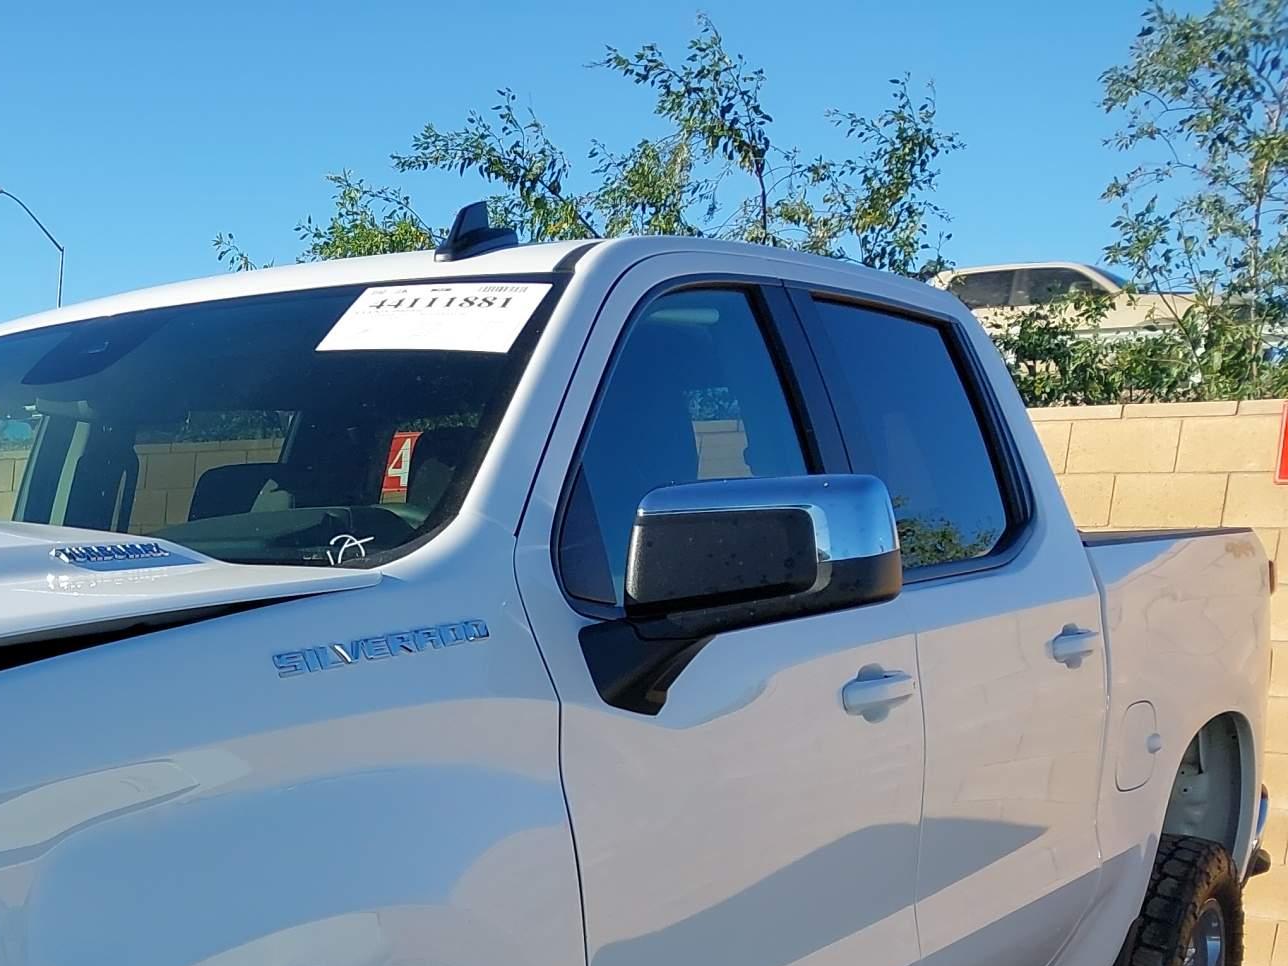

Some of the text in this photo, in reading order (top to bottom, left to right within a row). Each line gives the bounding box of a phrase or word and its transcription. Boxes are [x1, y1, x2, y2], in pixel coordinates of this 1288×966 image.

[369, 296, 513, 310] 44111881
[387, 437, 412, 487] 4
[49, 542, 170, 563] TURBOMAX
[271, 618, 491, 679] SILVERADO
